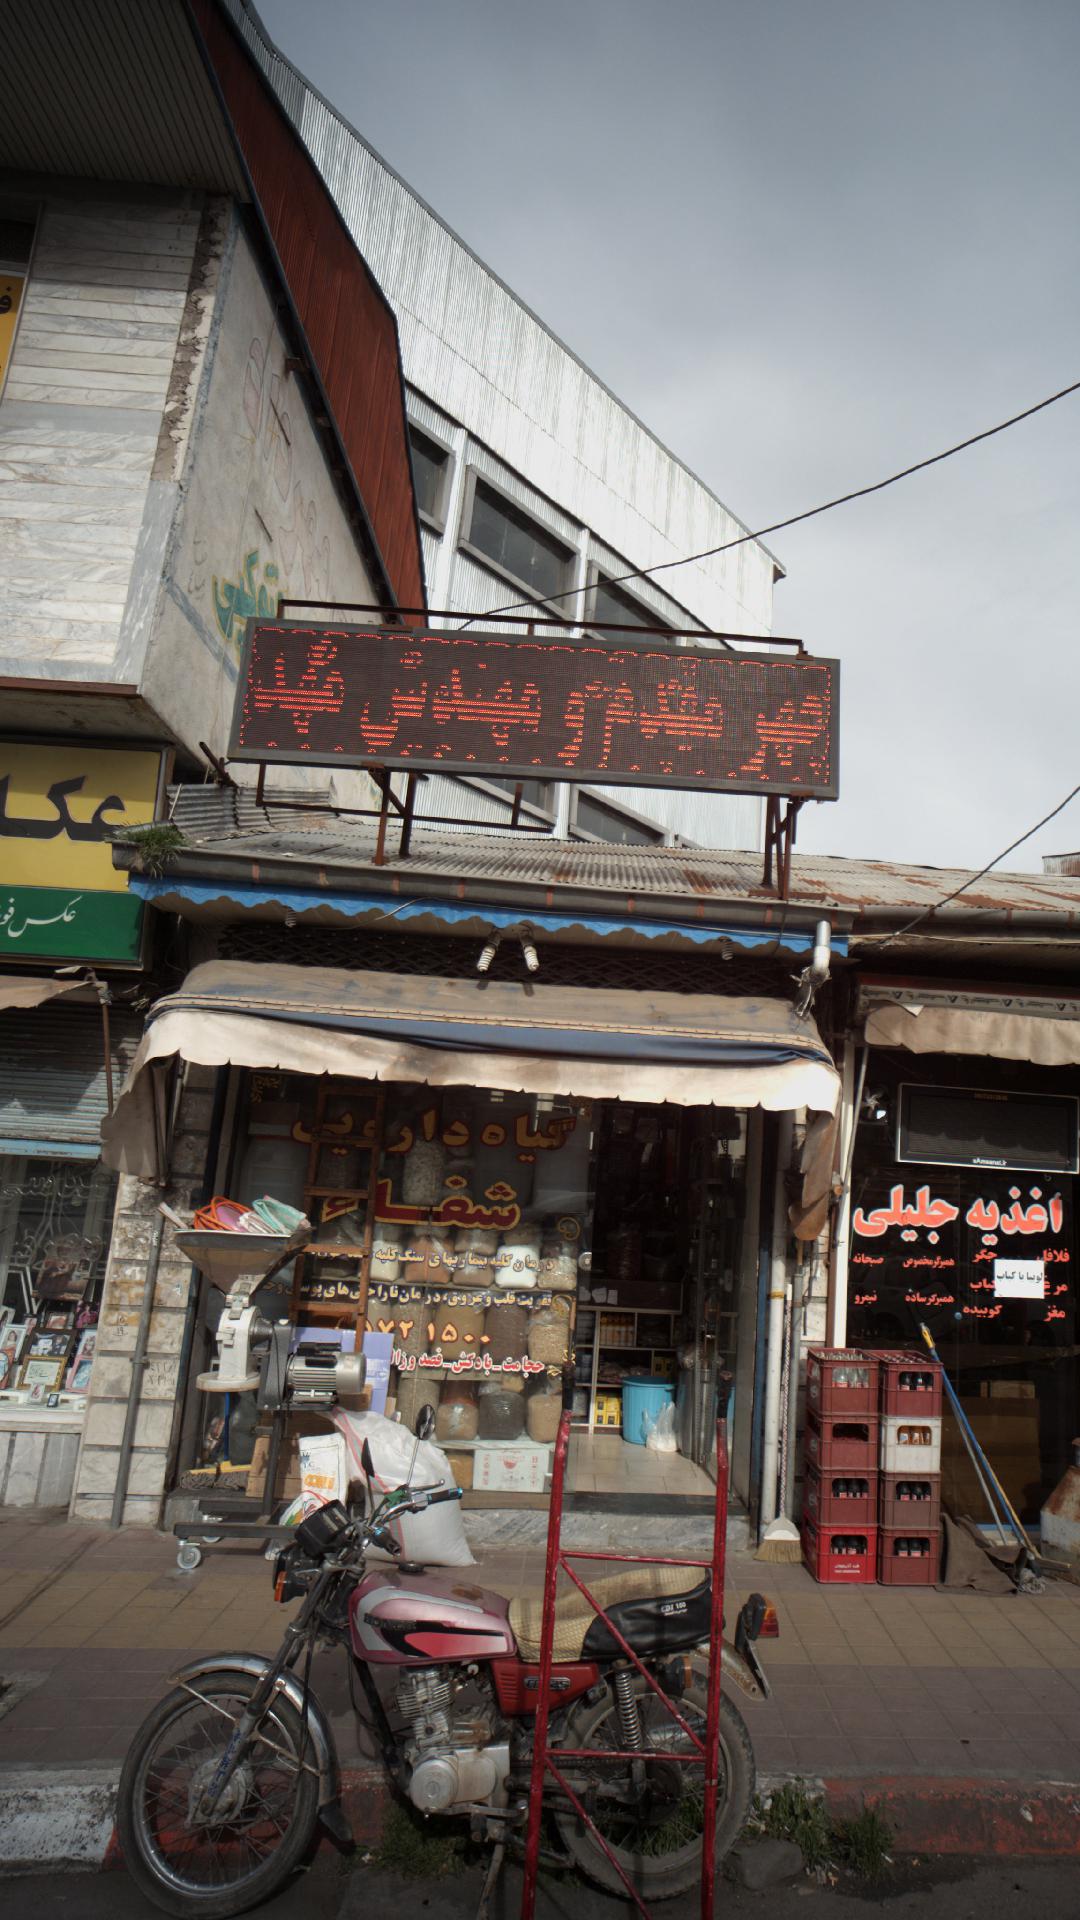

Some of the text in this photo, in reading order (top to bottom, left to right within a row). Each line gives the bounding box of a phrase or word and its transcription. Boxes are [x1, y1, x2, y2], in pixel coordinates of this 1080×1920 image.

[7, 894, 83, 938] عکس
[481, 1112, 577, 1163] گیاه
[852, 1183, 1064, 1246] اغذیه جلیلی
[852, 1252, 885, 1267] صبحانه
[493, 1291, 516, 1307] قلب
[854, 1289, 878, 1308] نیمرو
[962, 1303, 1004, 1319] کوبیده
[1043, 1304, 1066, 1322] مغز
